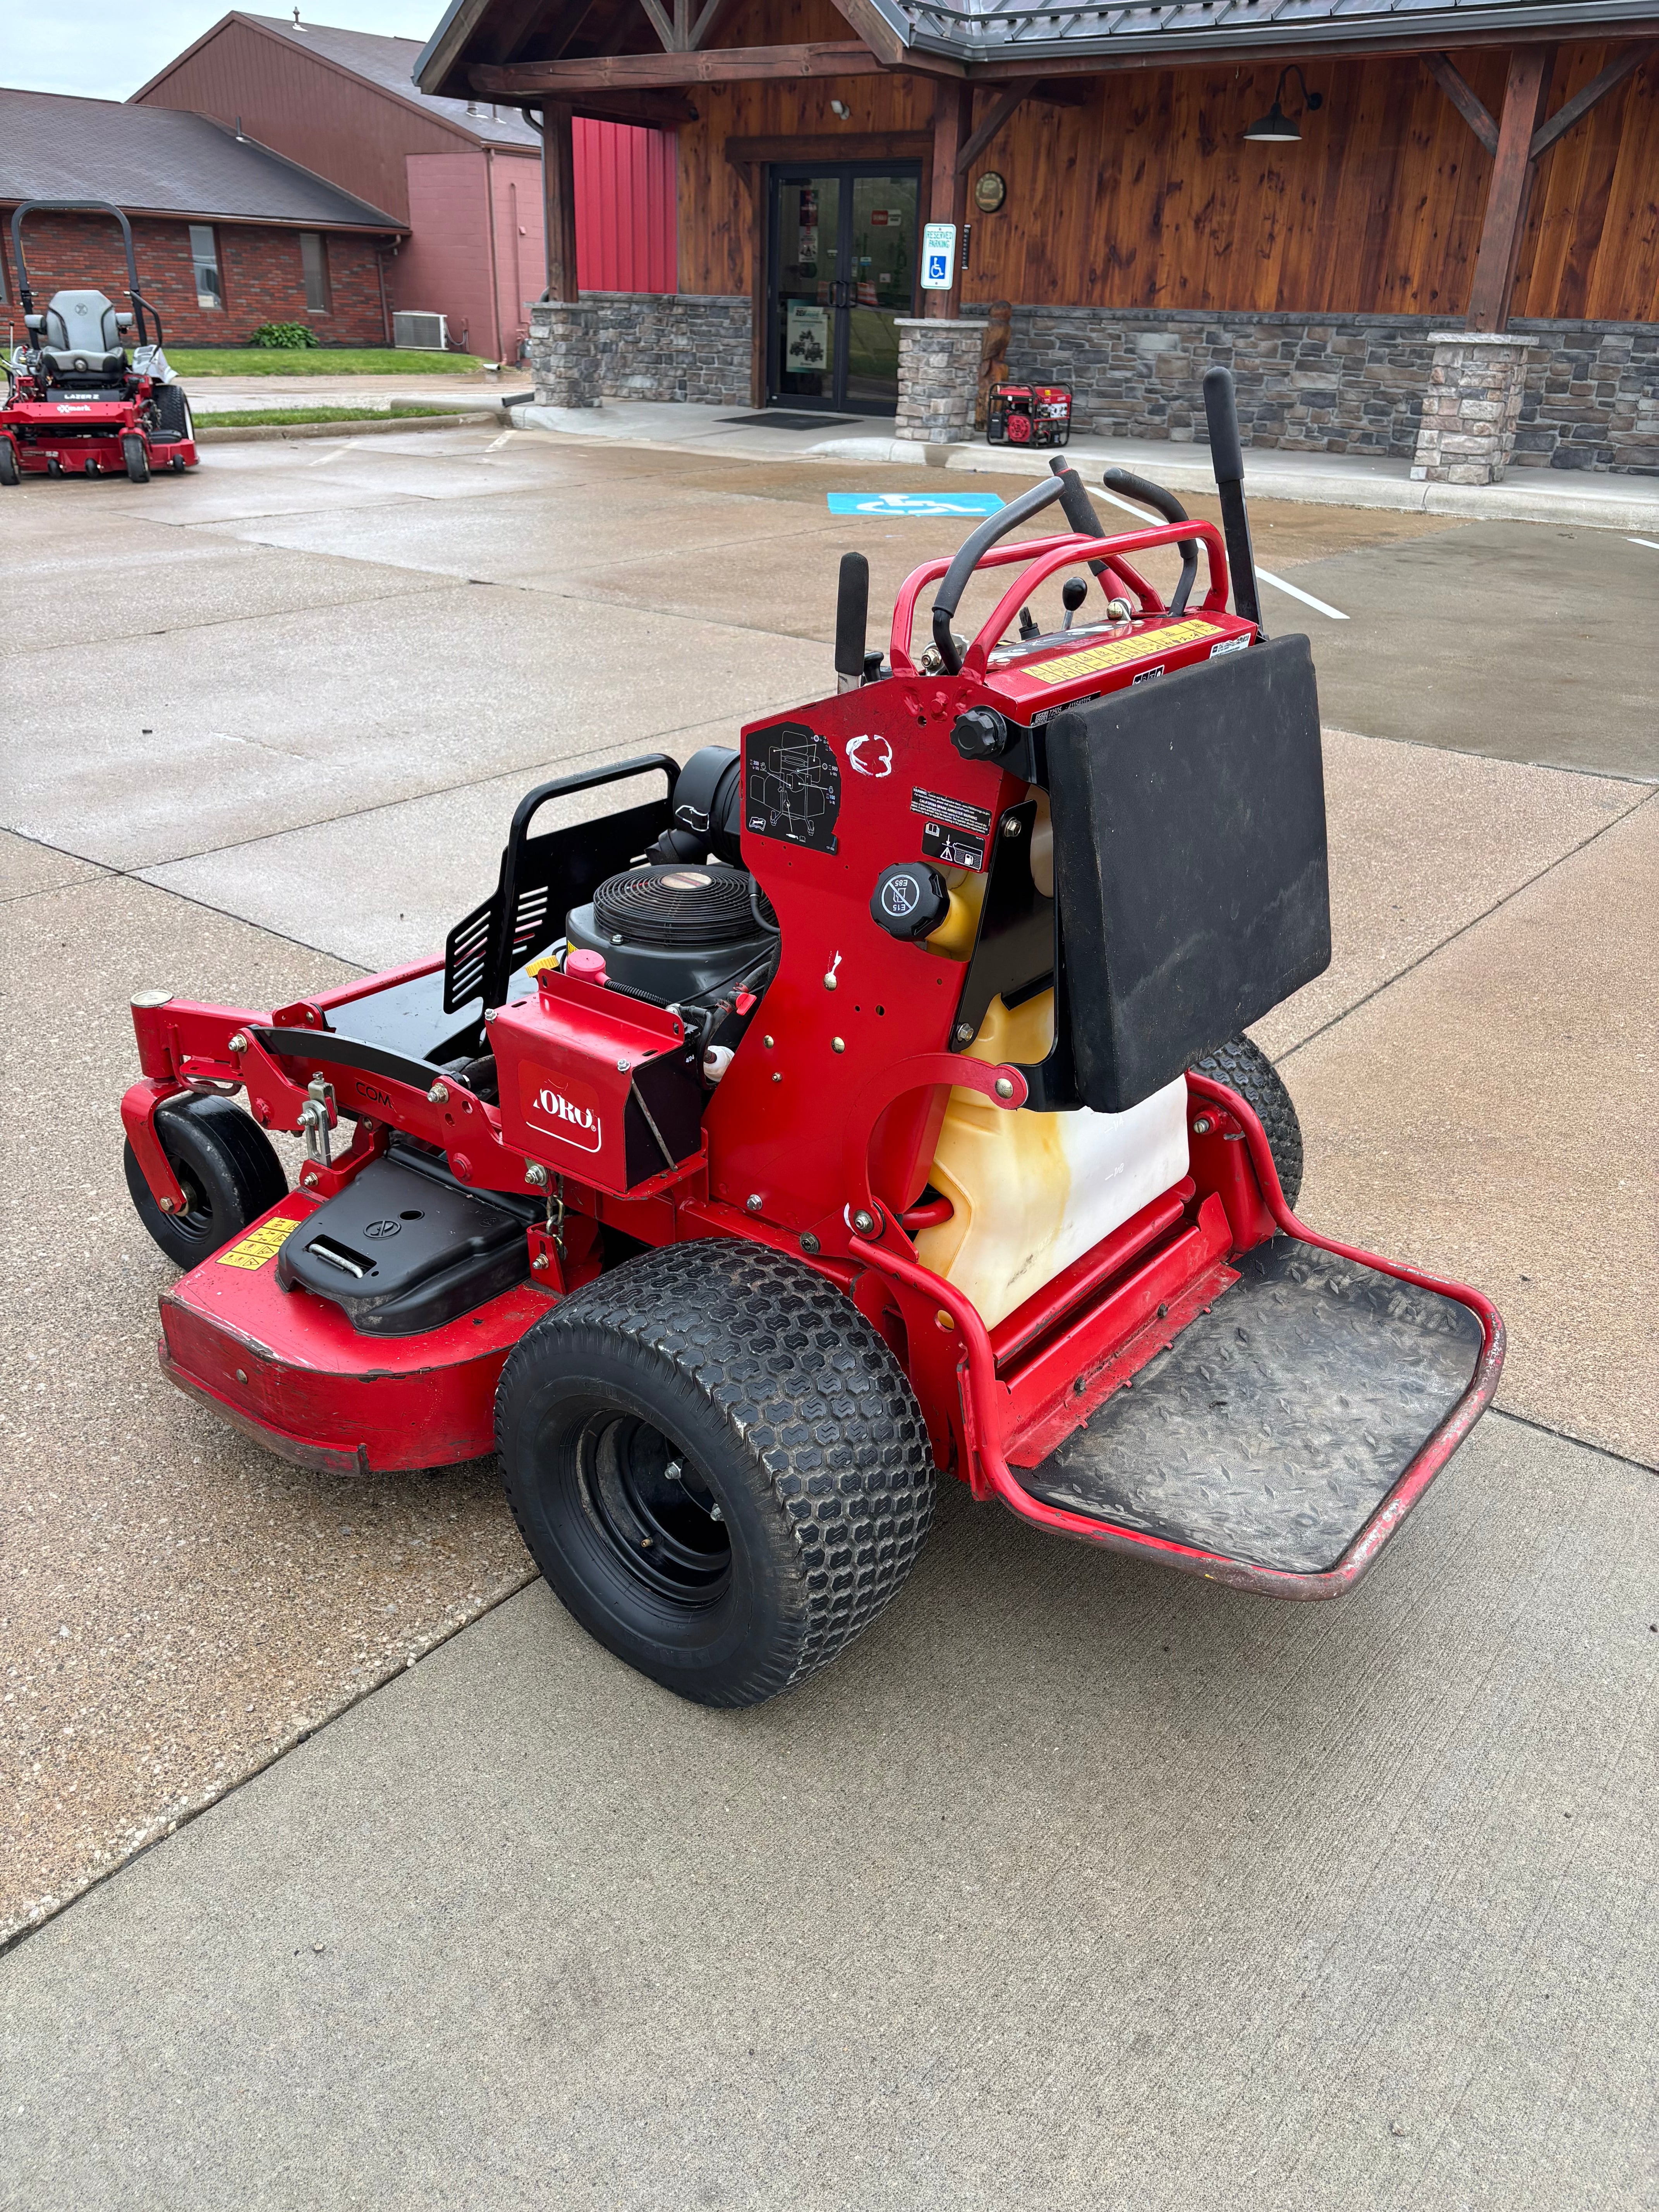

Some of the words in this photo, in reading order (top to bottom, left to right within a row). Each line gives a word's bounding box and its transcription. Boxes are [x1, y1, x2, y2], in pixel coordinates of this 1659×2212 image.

[927, 231, 952, 239] RESERVED
[928, 240, 950, 248] PARKING
[919, 798, 936, 807] CALIFORNIA
[947, 807, 962, 816] ARRESTER
[963, 812, 977, 821] WARNING
[533, 1089, 592, 1128] ORO
